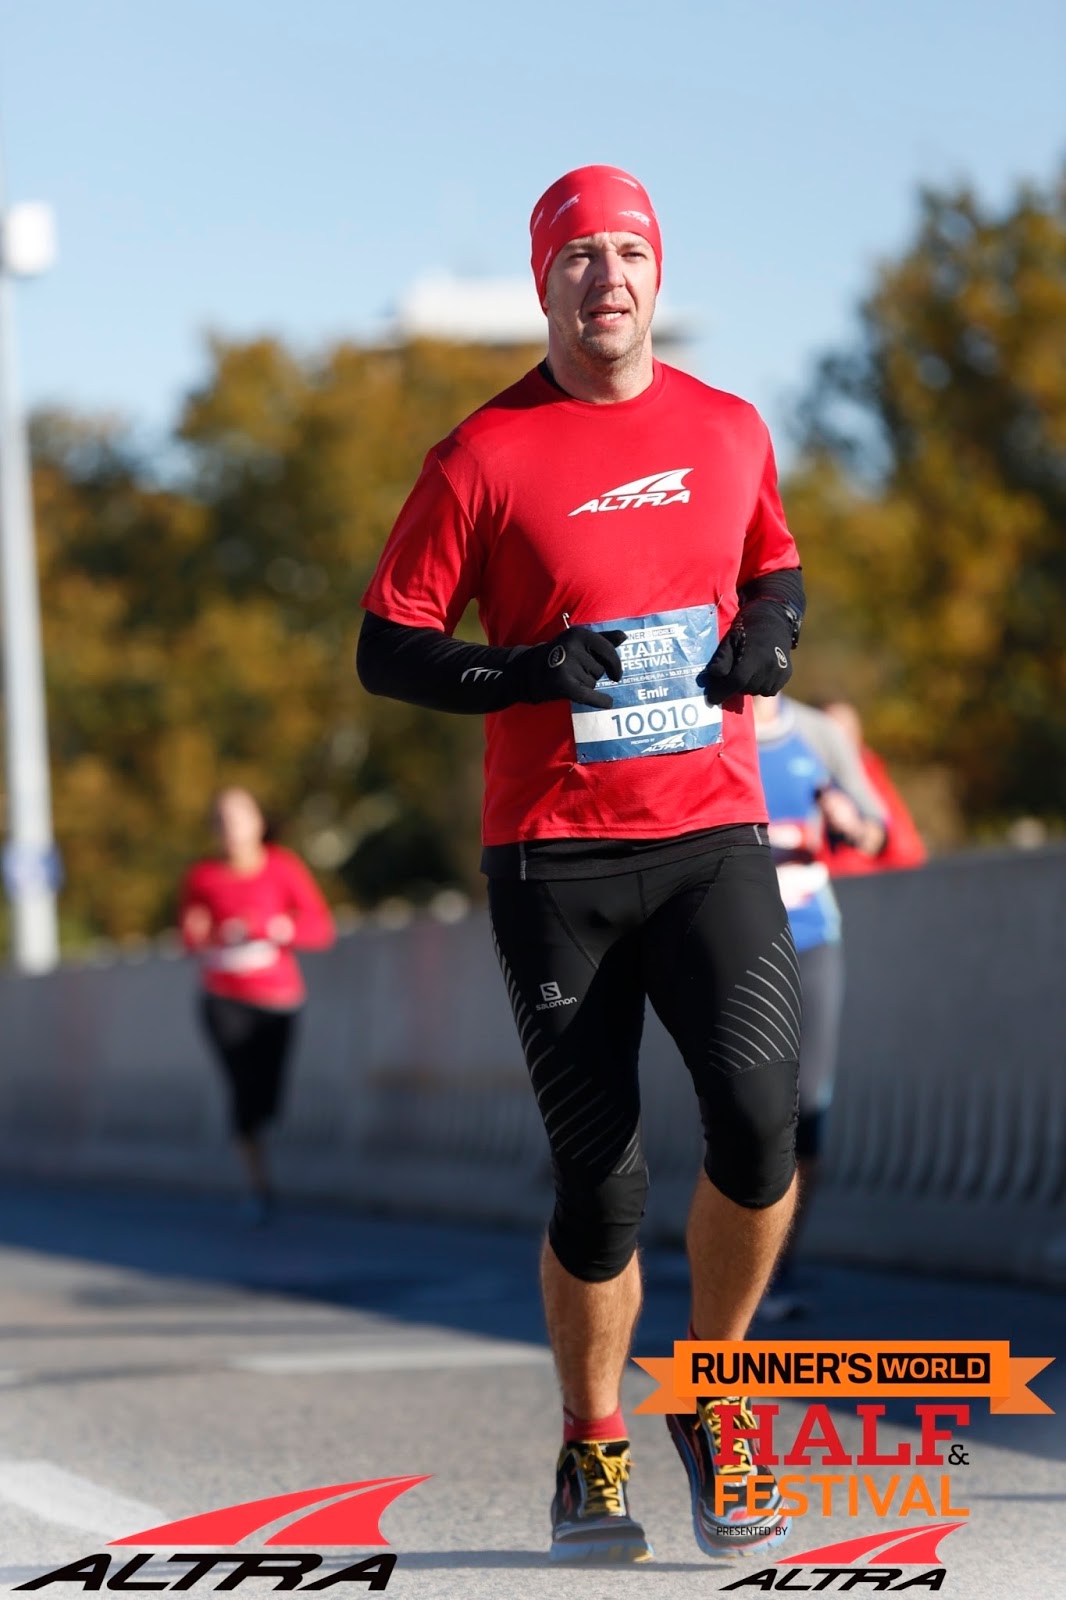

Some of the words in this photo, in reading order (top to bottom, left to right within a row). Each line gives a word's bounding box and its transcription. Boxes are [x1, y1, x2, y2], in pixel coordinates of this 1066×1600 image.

[567, 490, 691, 516] ALTRA
[620, 638, 674, 660] HALF
[621, 654, 676, 671] FESTIVAL
[637, 686, 669, 701] Emir
[611, 703, 699, 737] 10010
[640, 741, 685, 754] ALTRA
